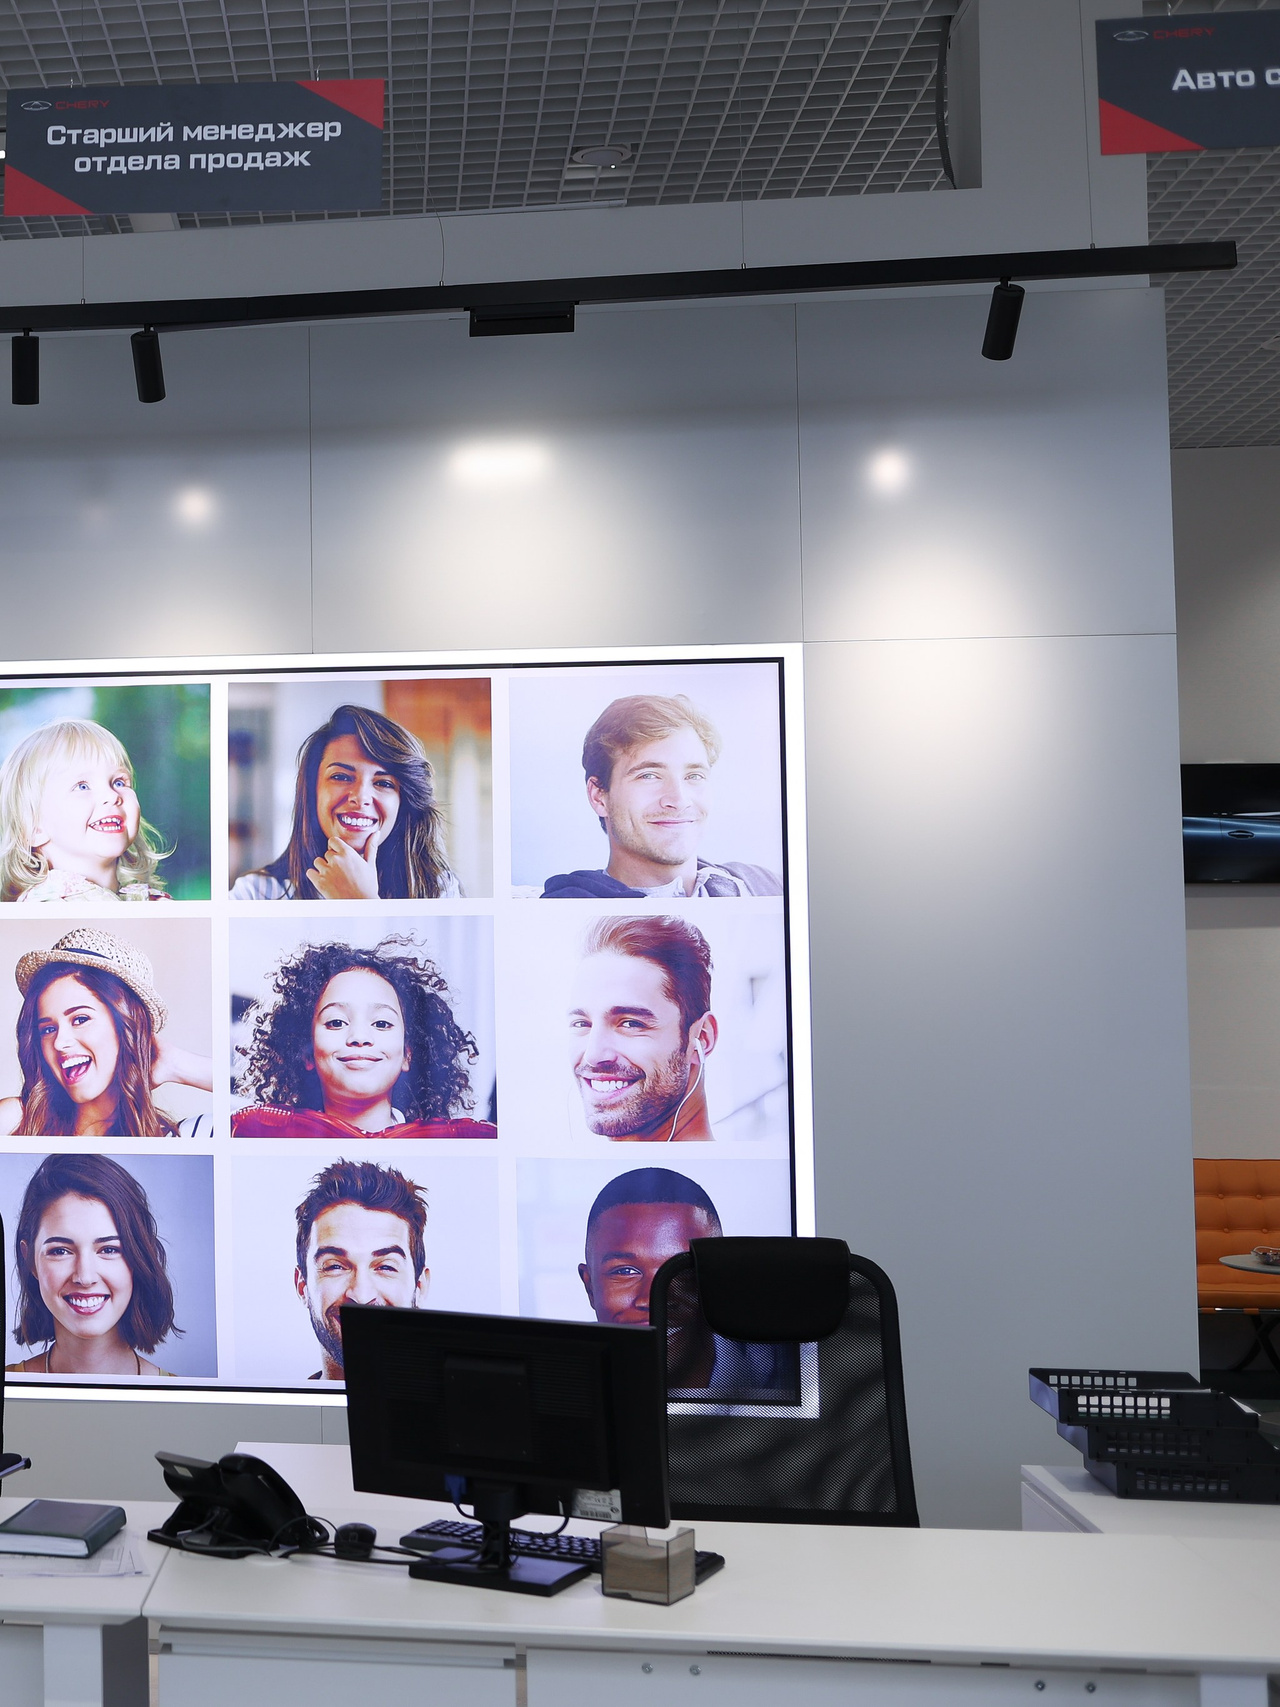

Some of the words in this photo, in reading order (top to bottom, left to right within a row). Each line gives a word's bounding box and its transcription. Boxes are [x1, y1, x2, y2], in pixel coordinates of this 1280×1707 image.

[1153, 28, 1216, 40] CHERY
[1172, 69, 1255, 91] Авто
[54, 100, 111, 110] CHERY
[46, 122, 174, 148] Старший
[182, 120, 342, 142] менеджер
[74, 153, 180, 175] отдела
[189, 148, 311, 173] продаж
